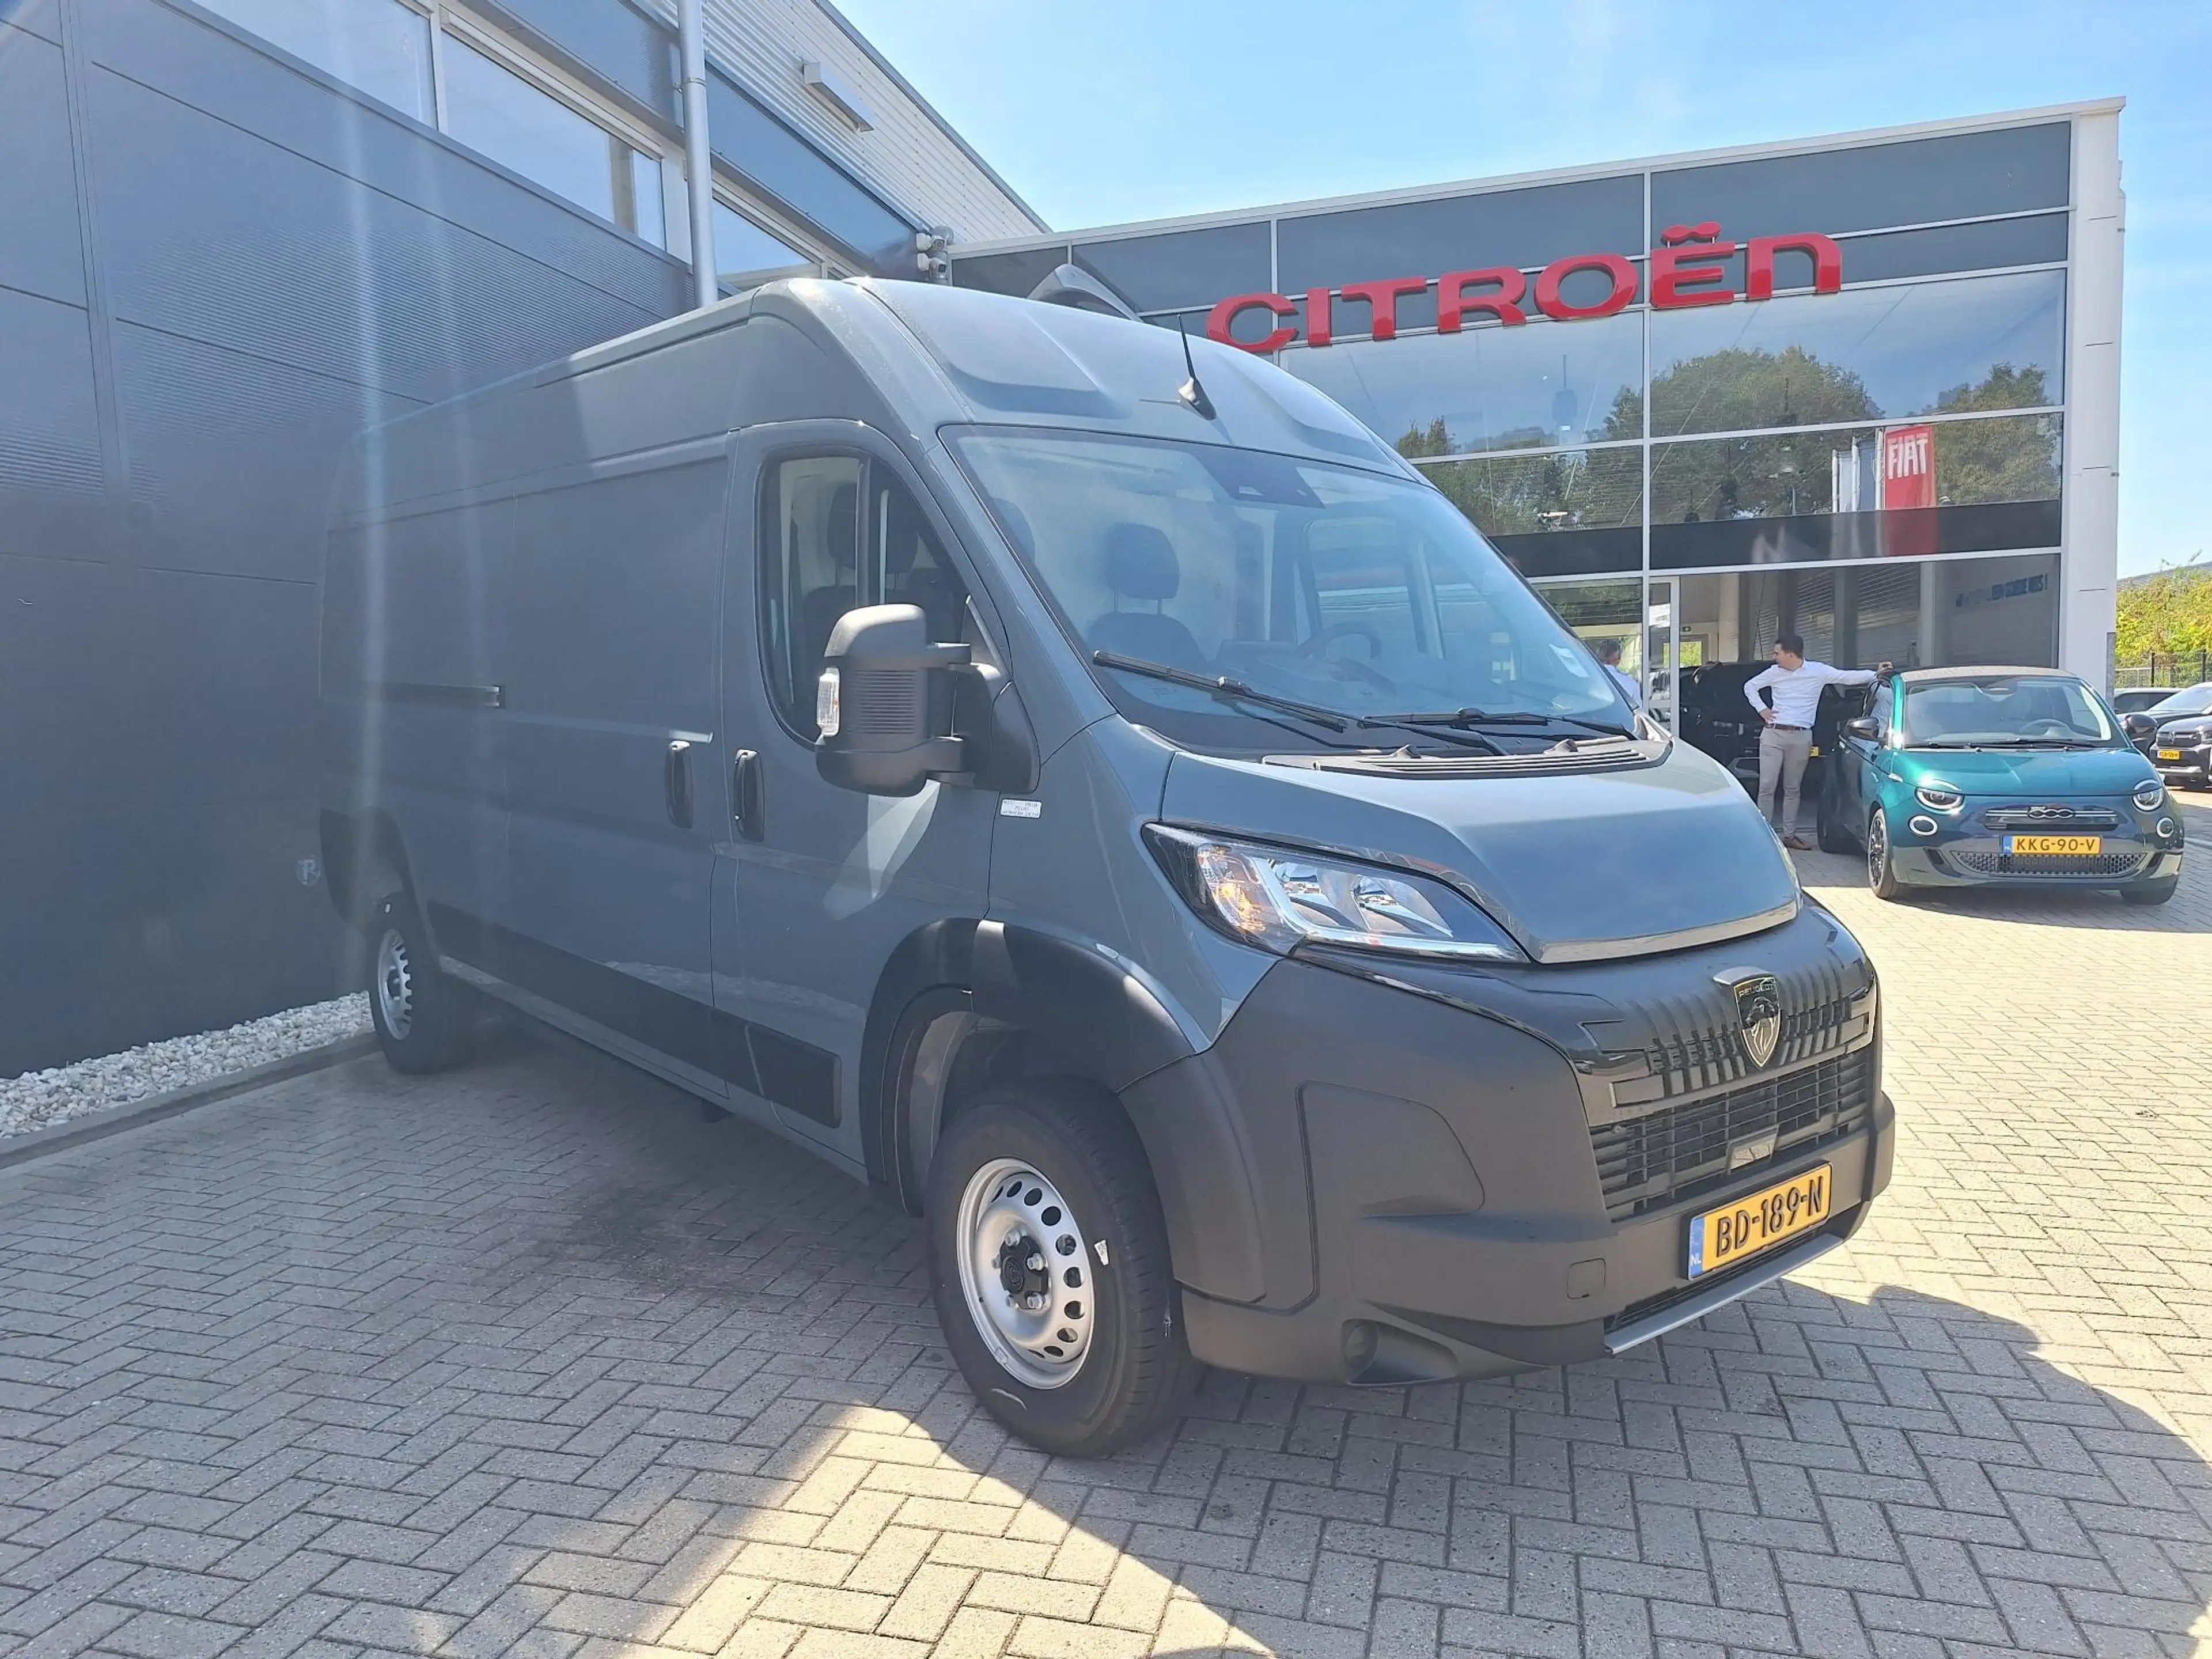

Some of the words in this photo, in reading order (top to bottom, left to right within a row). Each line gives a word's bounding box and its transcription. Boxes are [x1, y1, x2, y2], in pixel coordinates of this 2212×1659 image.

[1887, 434, 1929, 479] FIAT
[2016, 838, 2096, 851] KKG-90-V
[1716, 1175, 1824, 1257] BD-189-N
